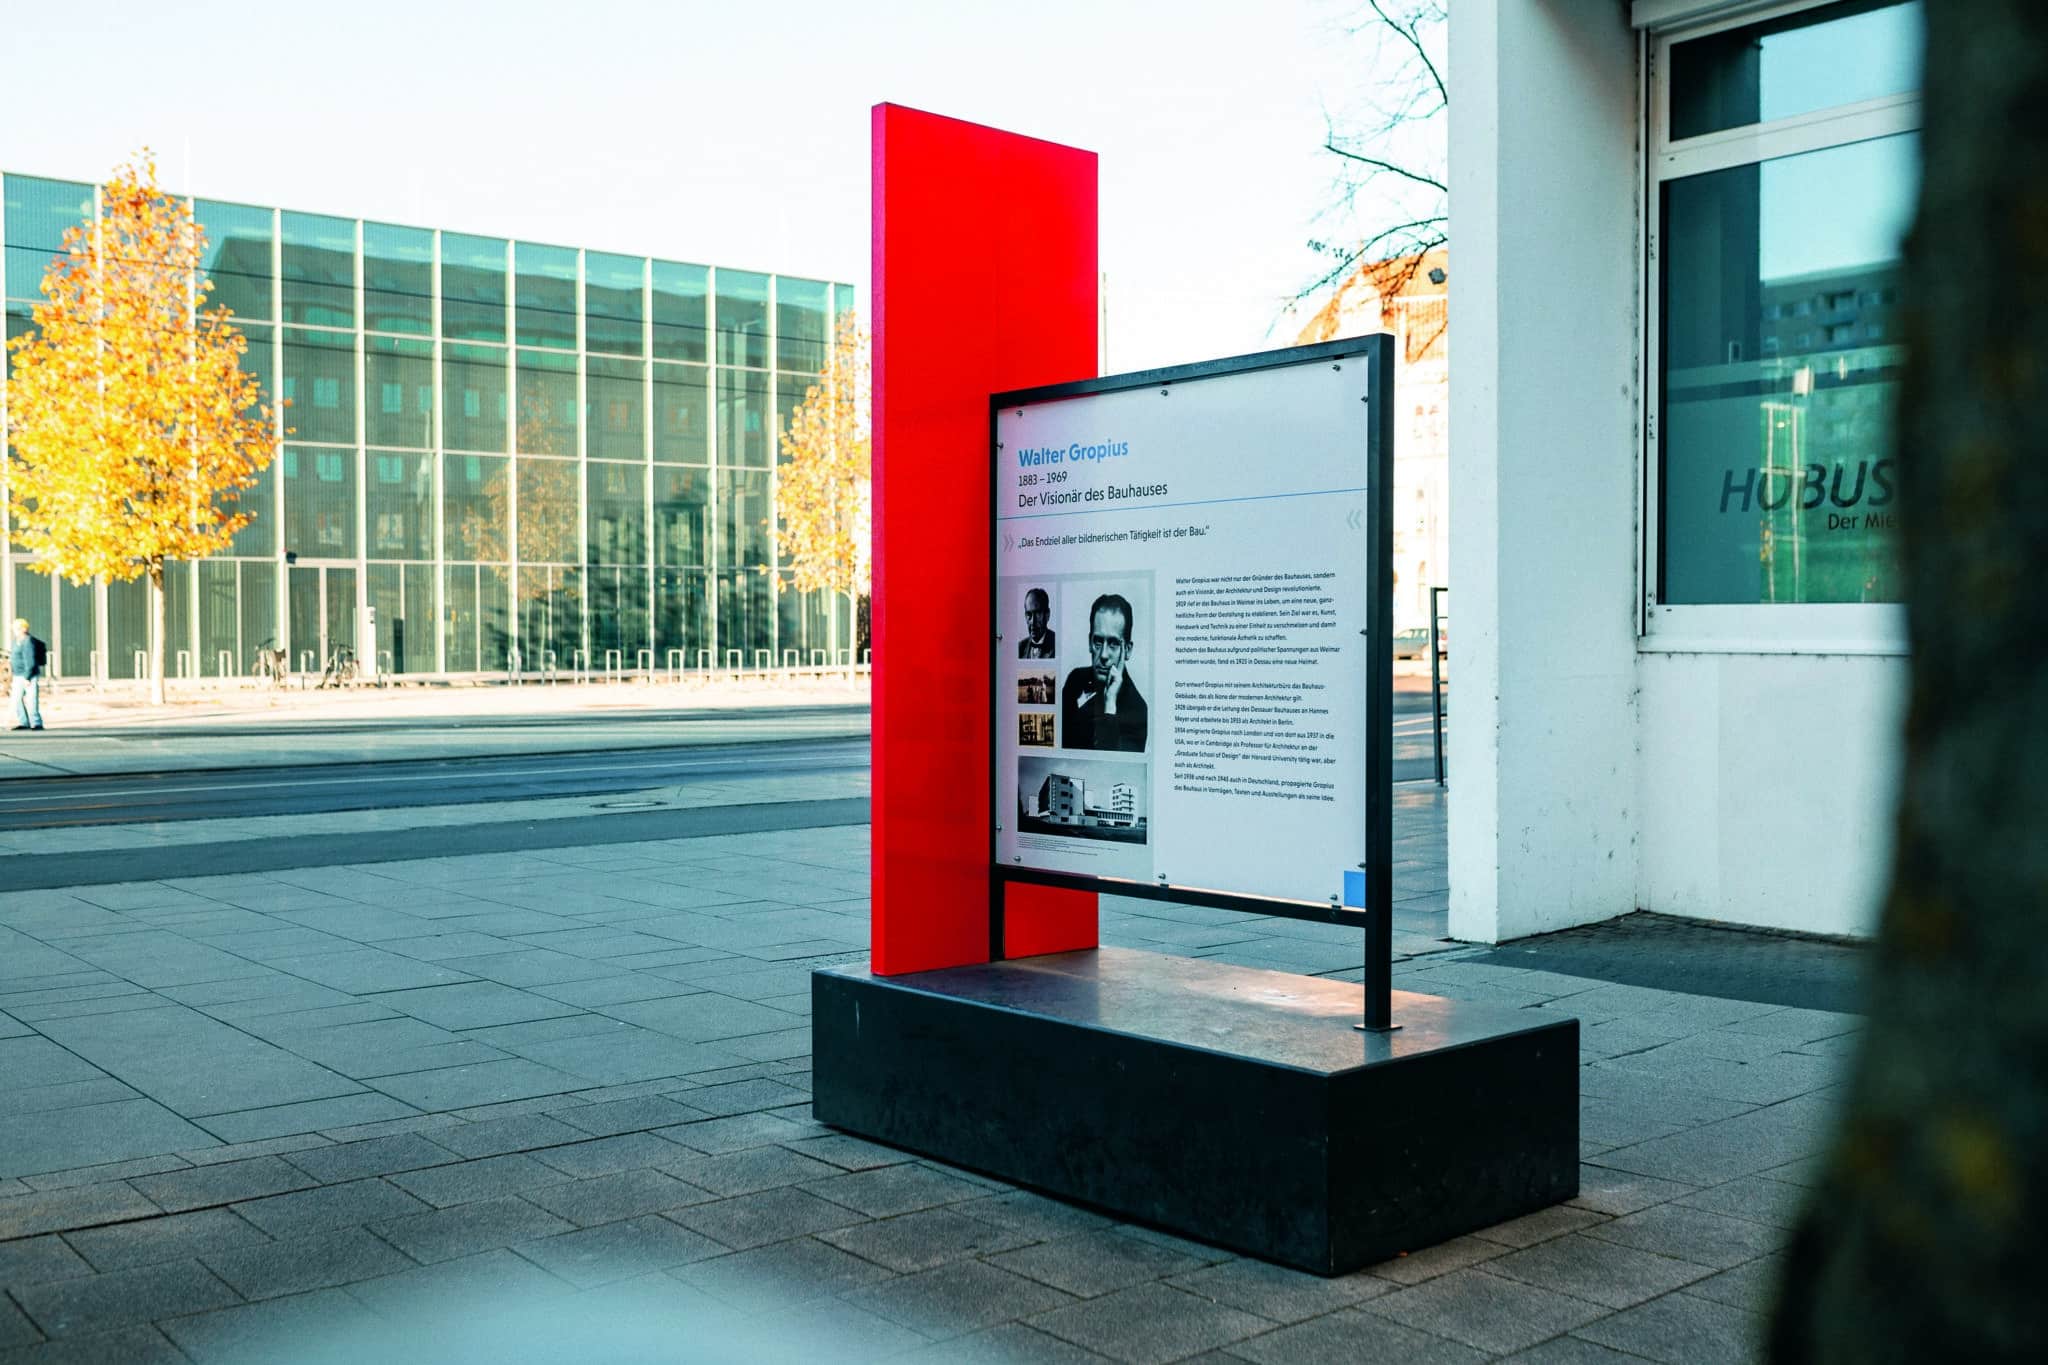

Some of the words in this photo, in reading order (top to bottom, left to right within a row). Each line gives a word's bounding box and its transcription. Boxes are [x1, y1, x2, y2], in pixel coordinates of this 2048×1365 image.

[1018, 447, 1065, 467] Walter
[1069, 438, 1129, 463] Gropius
[1018, 474, 1038, 487] 1883
[1046, 471, 1068, 484] 1969
[1018, 494, 1038, 507] Der
[1039, 488, 1082, 505] Visionär
[1084, 487, 1105, 502] des
[1108, 482, 1168, 500] Bauhauses
[1828, 513, 1859, 531] Der
[1035, 535, 1060, 547] Endziel
[1062, 535, 1077, 545] aller
[1079, 531, 1128, 543] bildnerischen
[1129, 528, 1161, 542] Tätigkeit
[1163, 528, 1172, 538] ist
[1173, 527, 1187, 538] der
